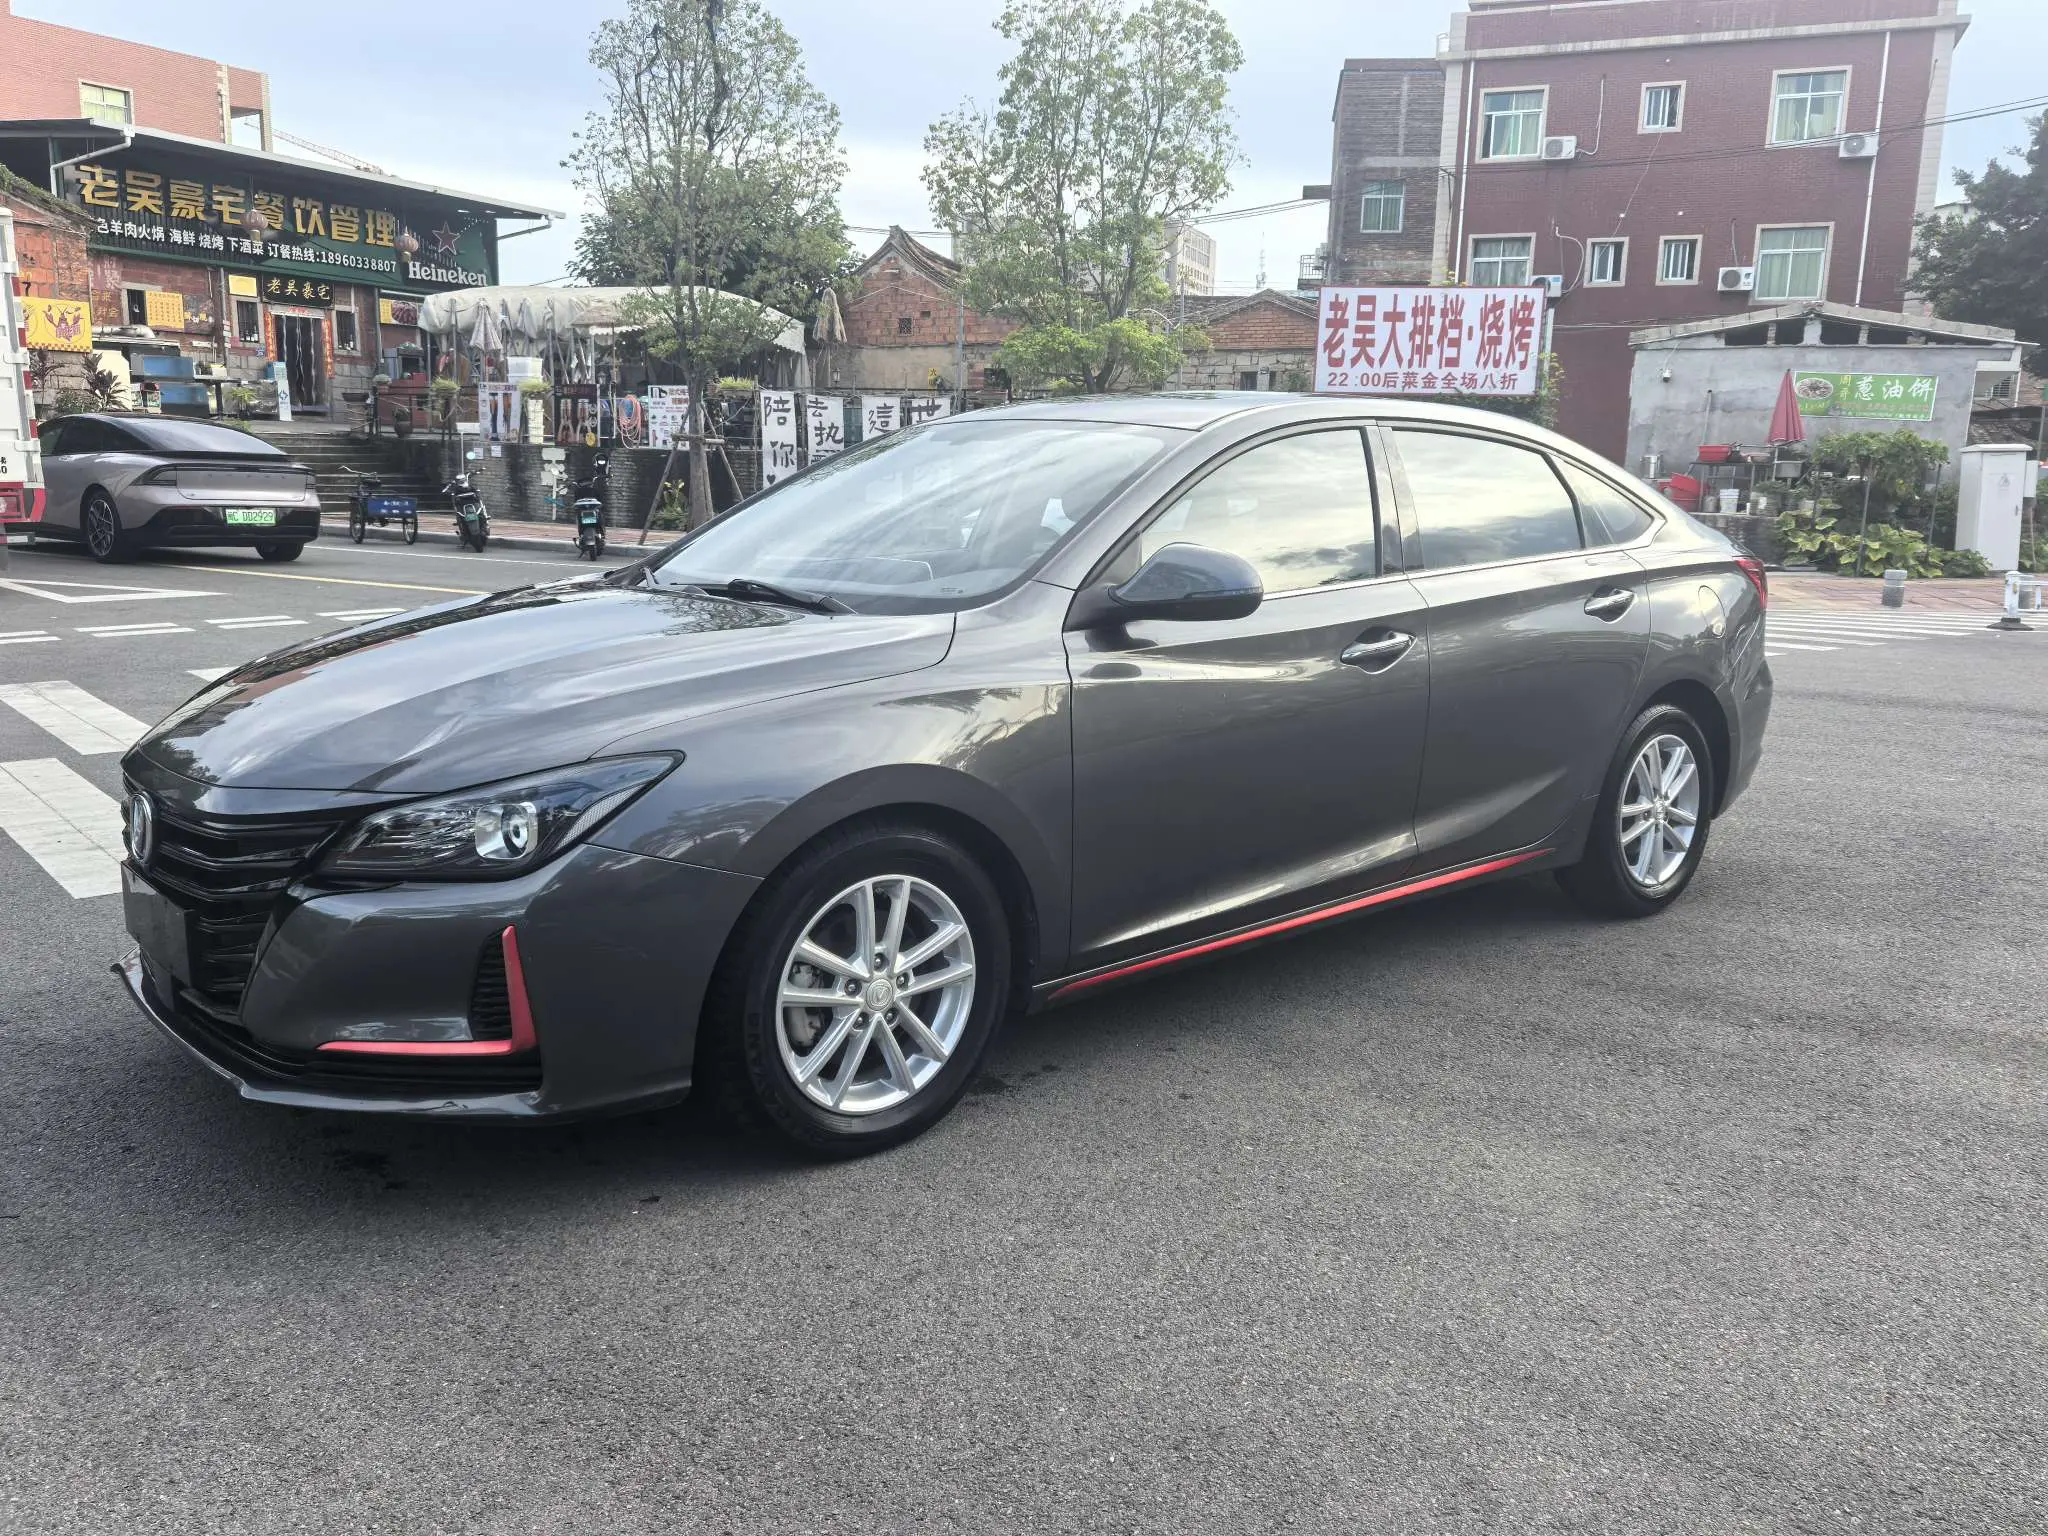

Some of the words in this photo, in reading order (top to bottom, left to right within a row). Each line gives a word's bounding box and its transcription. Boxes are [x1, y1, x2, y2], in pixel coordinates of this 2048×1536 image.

[78, 164, 396, 246] 老吴豪宅餐饮管理
[169, 228, 196, 245] 海鲜
[199, 233, 224, 251] 烧烤
[227, 236, 264, 256] 下酒菜
[266, 278, 330, 301] 老吴豪宅
[408, 261, 488, 286] Heineken
[1323, 293, 1536, 371] 老吴大排档·烧烤
[764, 396, 795, 468] 陪你
